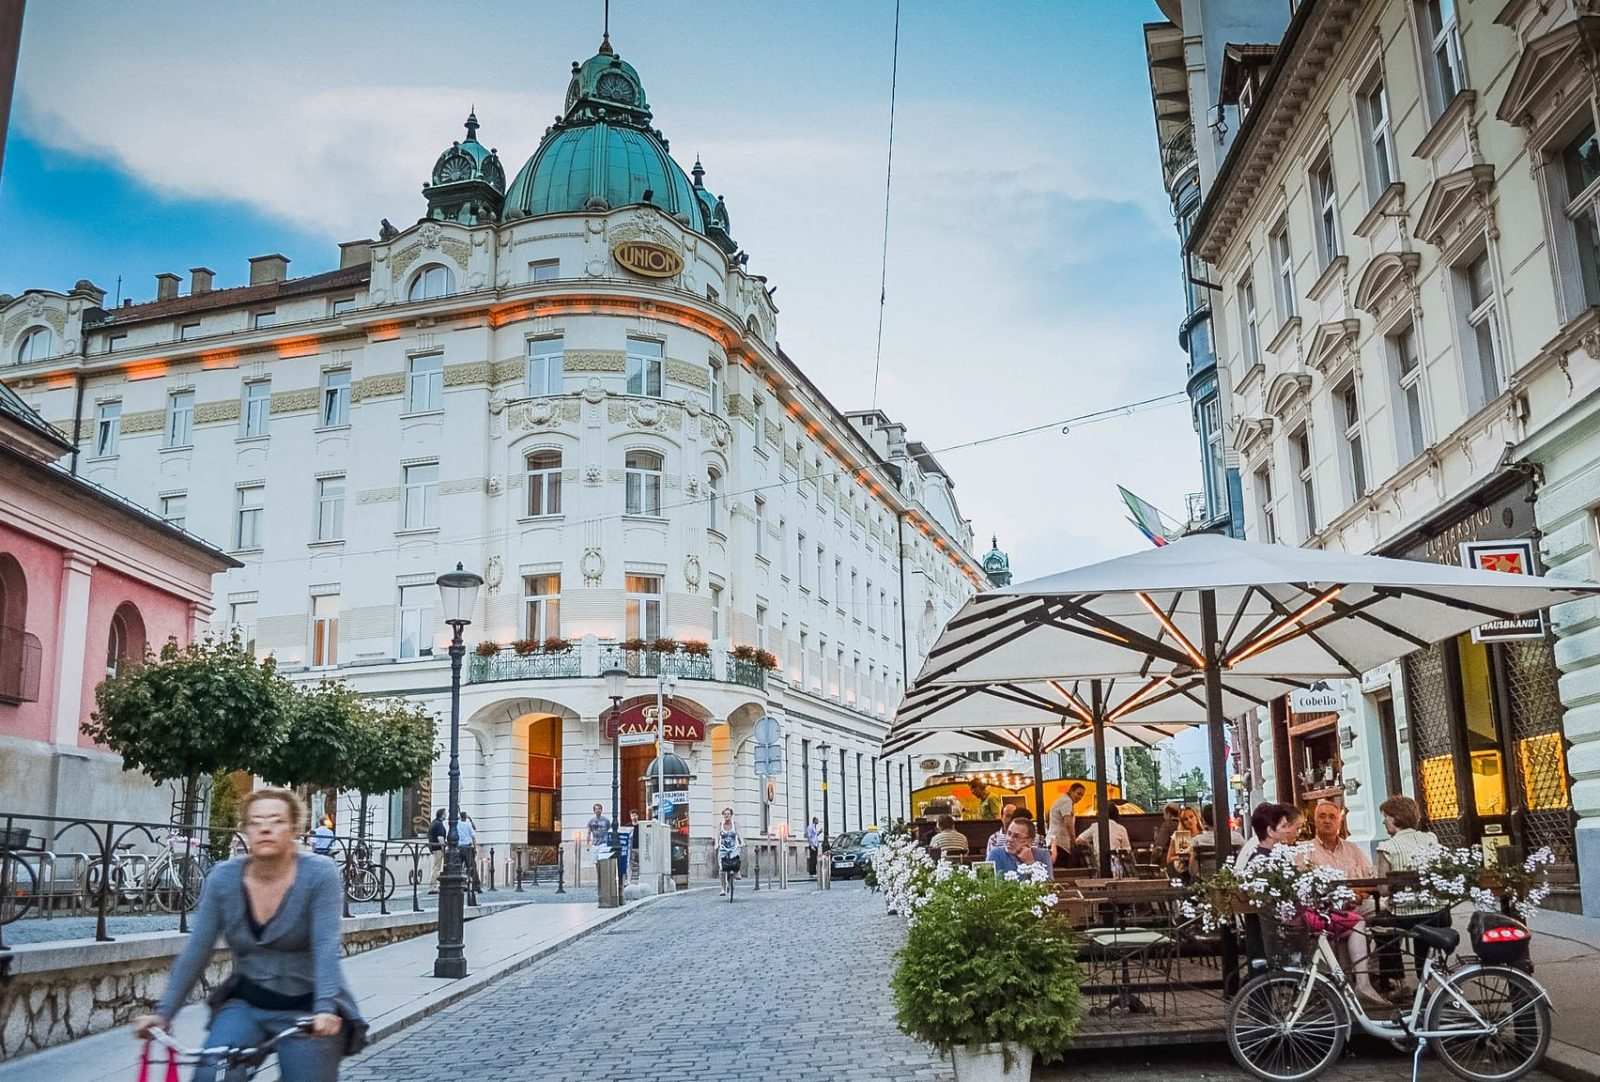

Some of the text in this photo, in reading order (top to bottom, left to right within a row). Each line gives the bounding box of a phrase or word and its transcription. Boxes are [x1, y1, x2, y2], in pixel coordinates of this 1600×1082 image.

[624, 245, 676, 272] UNION
[1480, 619, 1540, 630] HAUSBRANDT
[618, 723, 697, 738] KAVARNA
